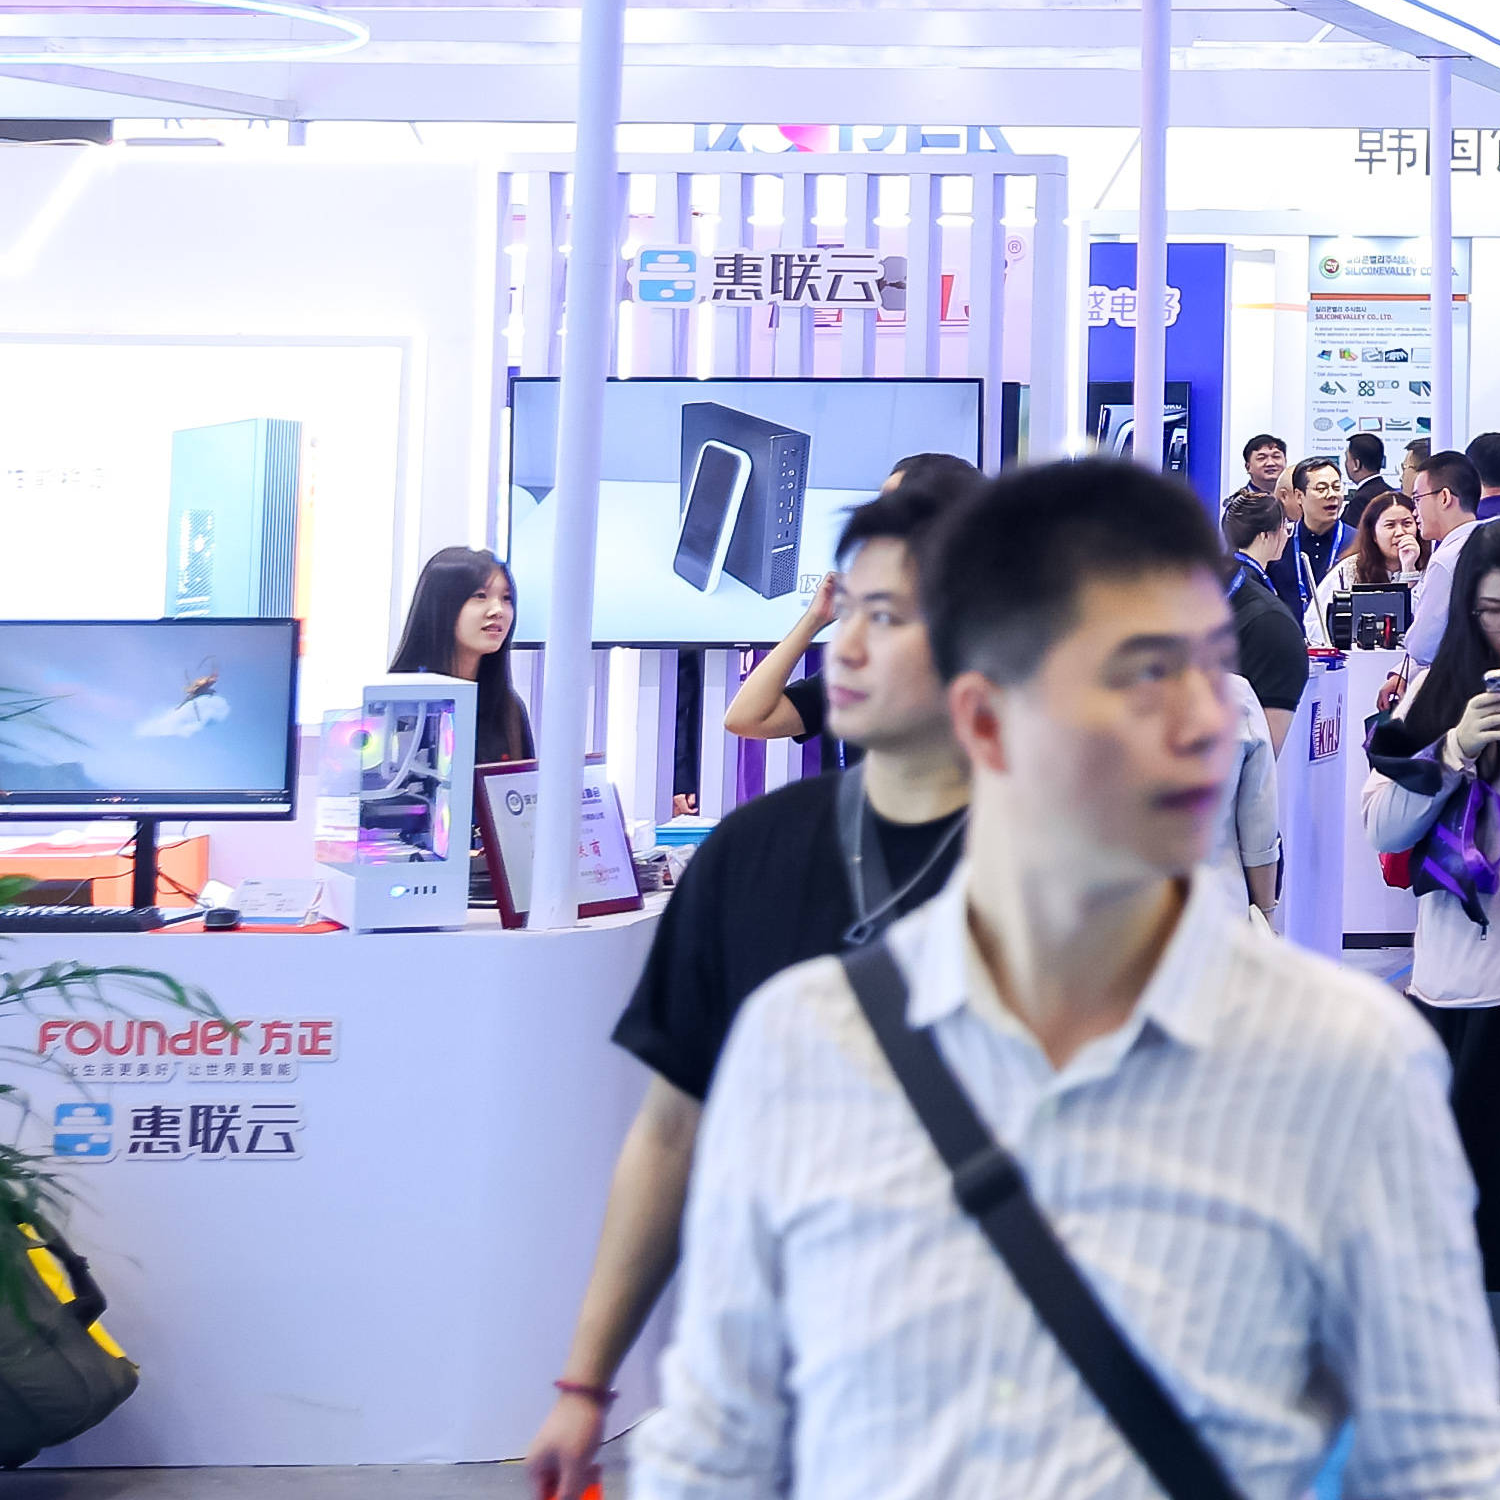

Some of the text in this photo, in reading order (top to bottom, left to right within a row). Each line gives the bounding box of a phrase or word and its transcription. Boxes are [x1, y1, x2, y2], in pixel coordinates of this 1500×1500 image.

[712, 253, 877, 301] 惠联云
[258, 1020, 333, 1056] 方正
[187, 1062, 292, 1077] 让世界更智能
[128, 1104, 300, 1155] 惠联云
